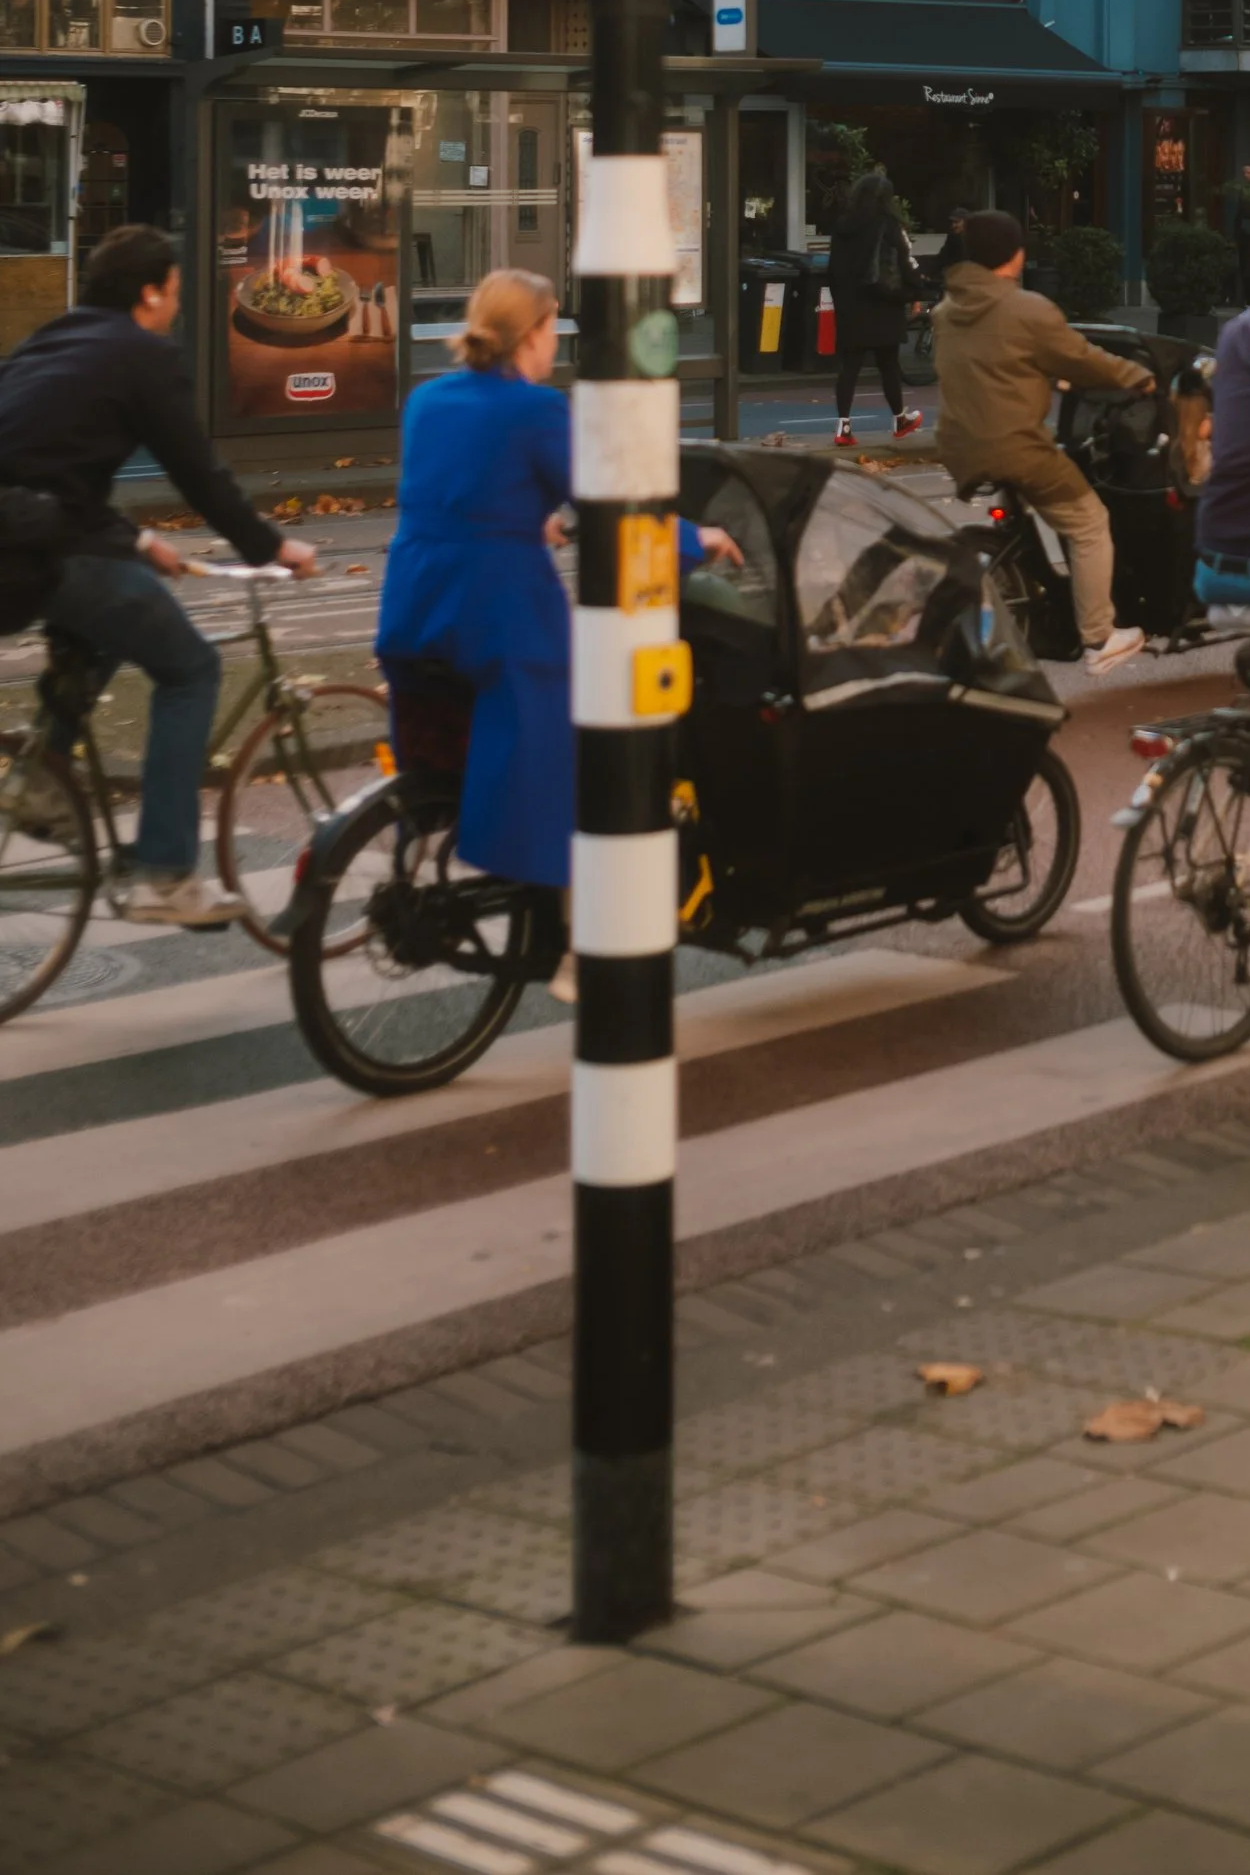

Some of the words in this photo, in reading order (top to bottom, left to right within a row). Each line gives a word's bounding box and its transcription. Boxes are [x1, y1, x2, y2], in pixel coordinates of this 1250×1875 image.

[923, 85, 967, 104] Restaurant
[248, 164, 289, 179] Het
[296, 164, 317, 180] is
[324, 167, 382, 180] weer
[250, 183, 309, 199] Unox
[315, 186, 378, 200] weer.
